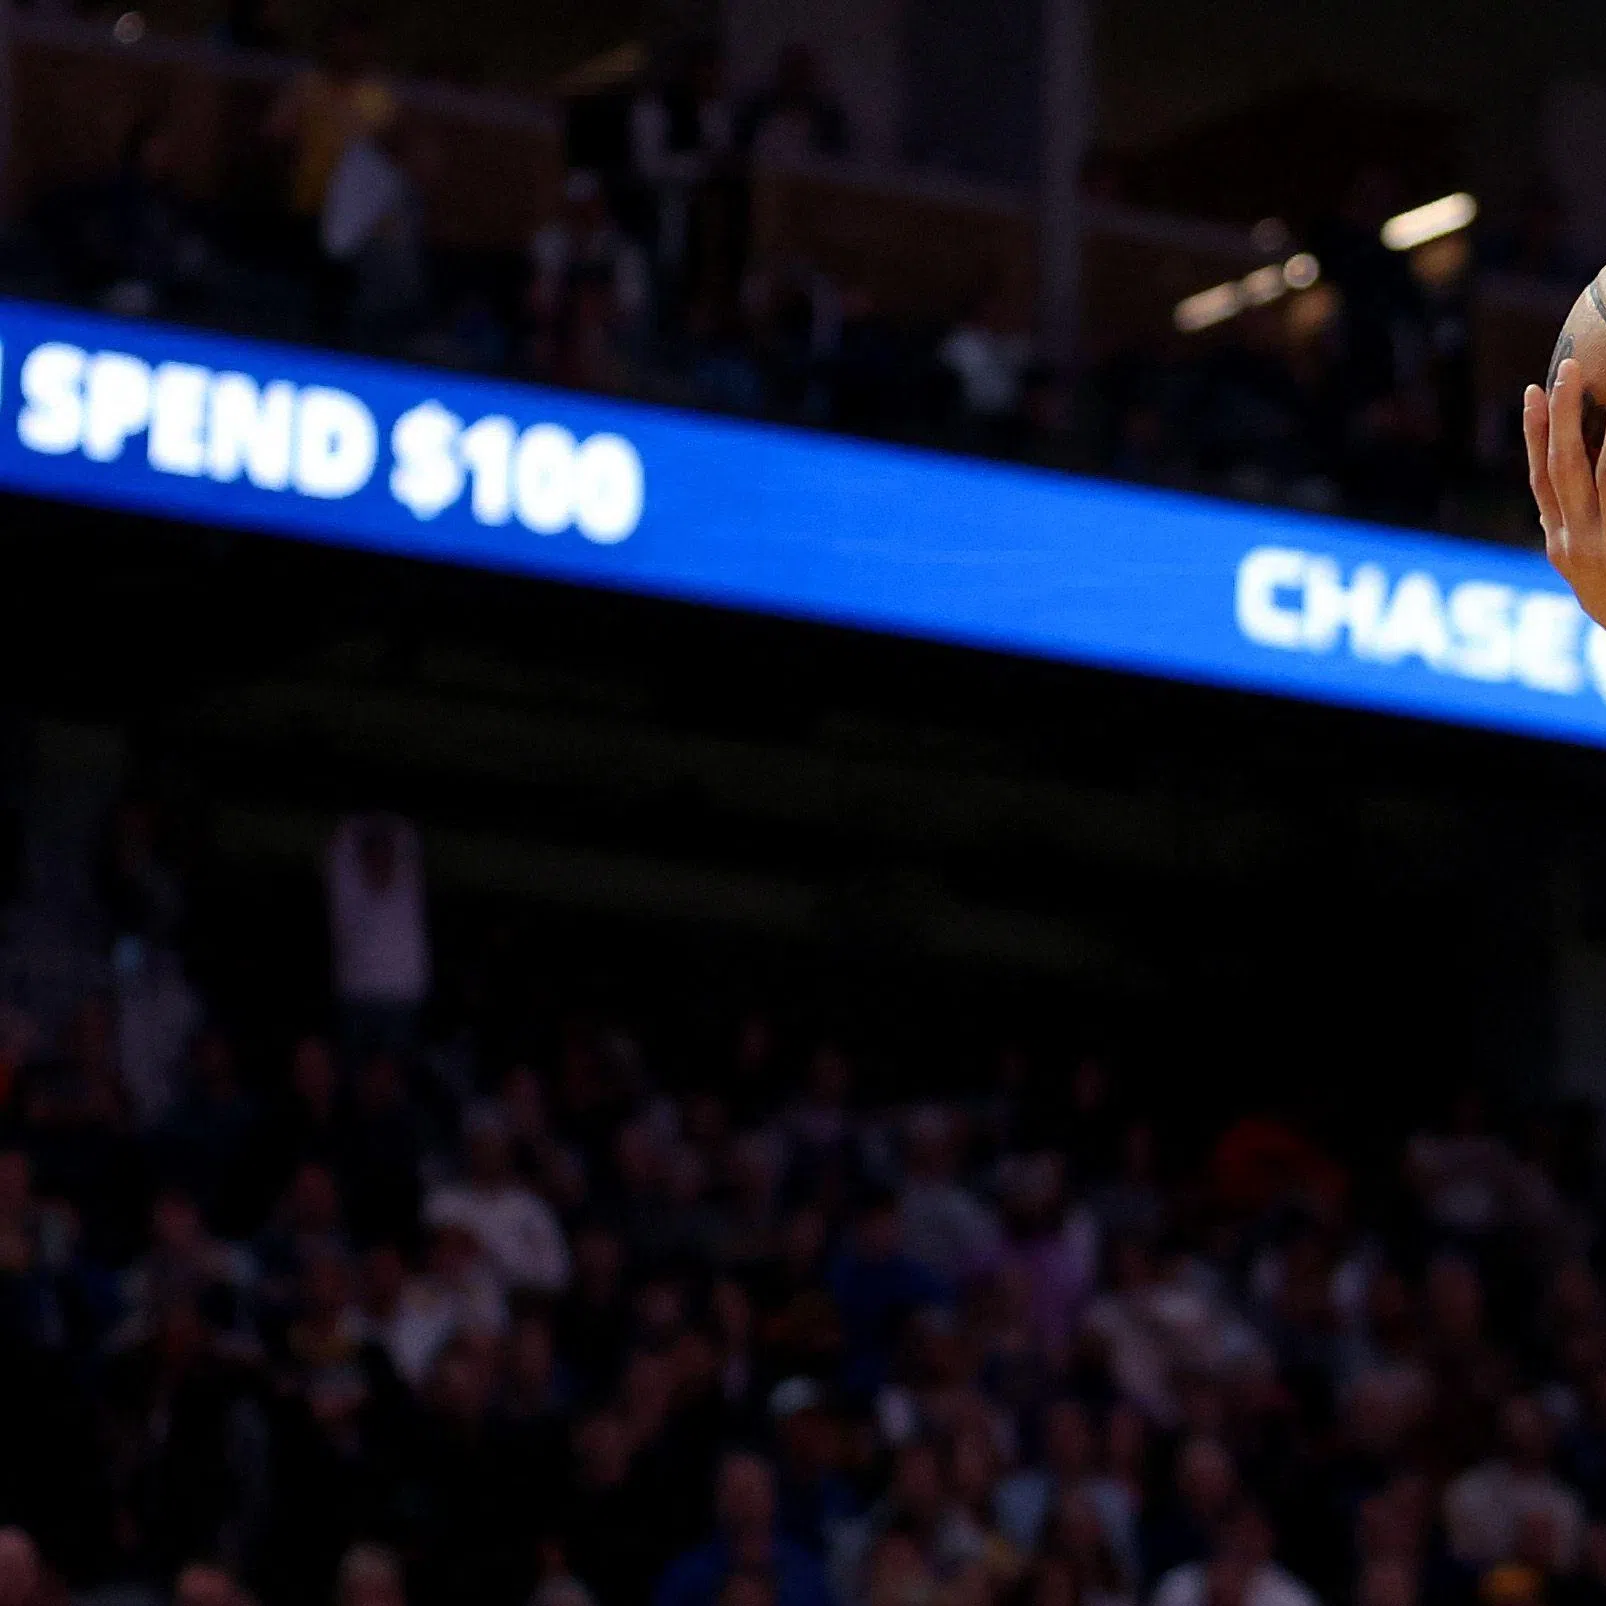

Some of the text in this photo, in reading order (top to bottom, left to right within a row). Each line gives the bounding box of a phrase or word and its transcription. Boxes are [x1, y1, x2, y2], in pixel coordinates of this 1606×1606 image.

[17, 341, 644, 544] SPEND $100
[1236, 546, 1584, 694] CHASE
